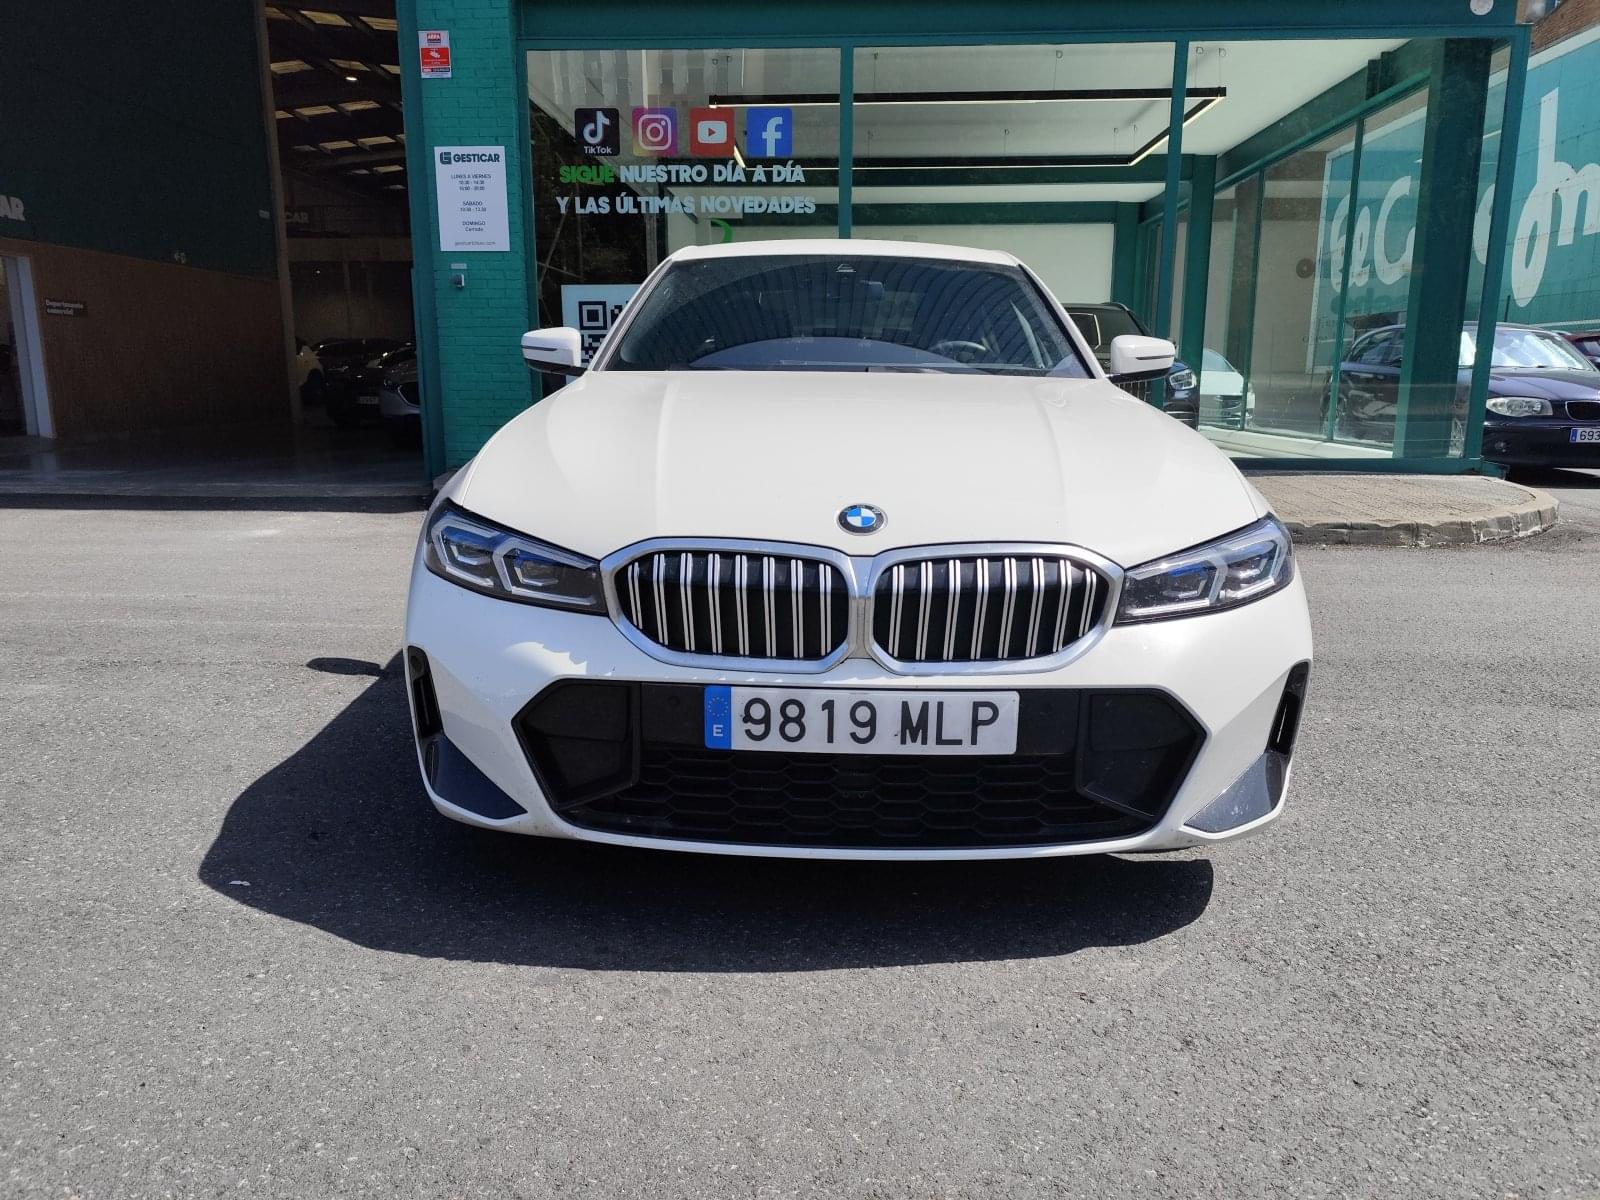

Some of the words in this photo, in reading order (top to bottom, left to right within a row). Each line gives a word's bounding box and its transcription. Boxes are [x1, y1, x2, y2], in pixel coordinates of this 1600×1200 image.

[453, 153, 500, 163] GESTICAR
[583, 145, 612, 155] TikTok
[559, 164, 615, 184] SIGUE
[620, 164, 708, 184] NUESTRO
[713, 159, 746, 184] DÍA
[752, 165, 767, 184] A
[773, 159, 806, 184] DÍA
[556, 196, 570, 215] Y
[575, 196, 611, 215] LAS
[615, 191, 697, 215] ÚLTIMAS
[701, 195, 816, 215] NOVEDADES
[712, 724, 724, 737] E
[742, 696, 877, 745] 9819
[900, 700, 1000, 746] MLP
